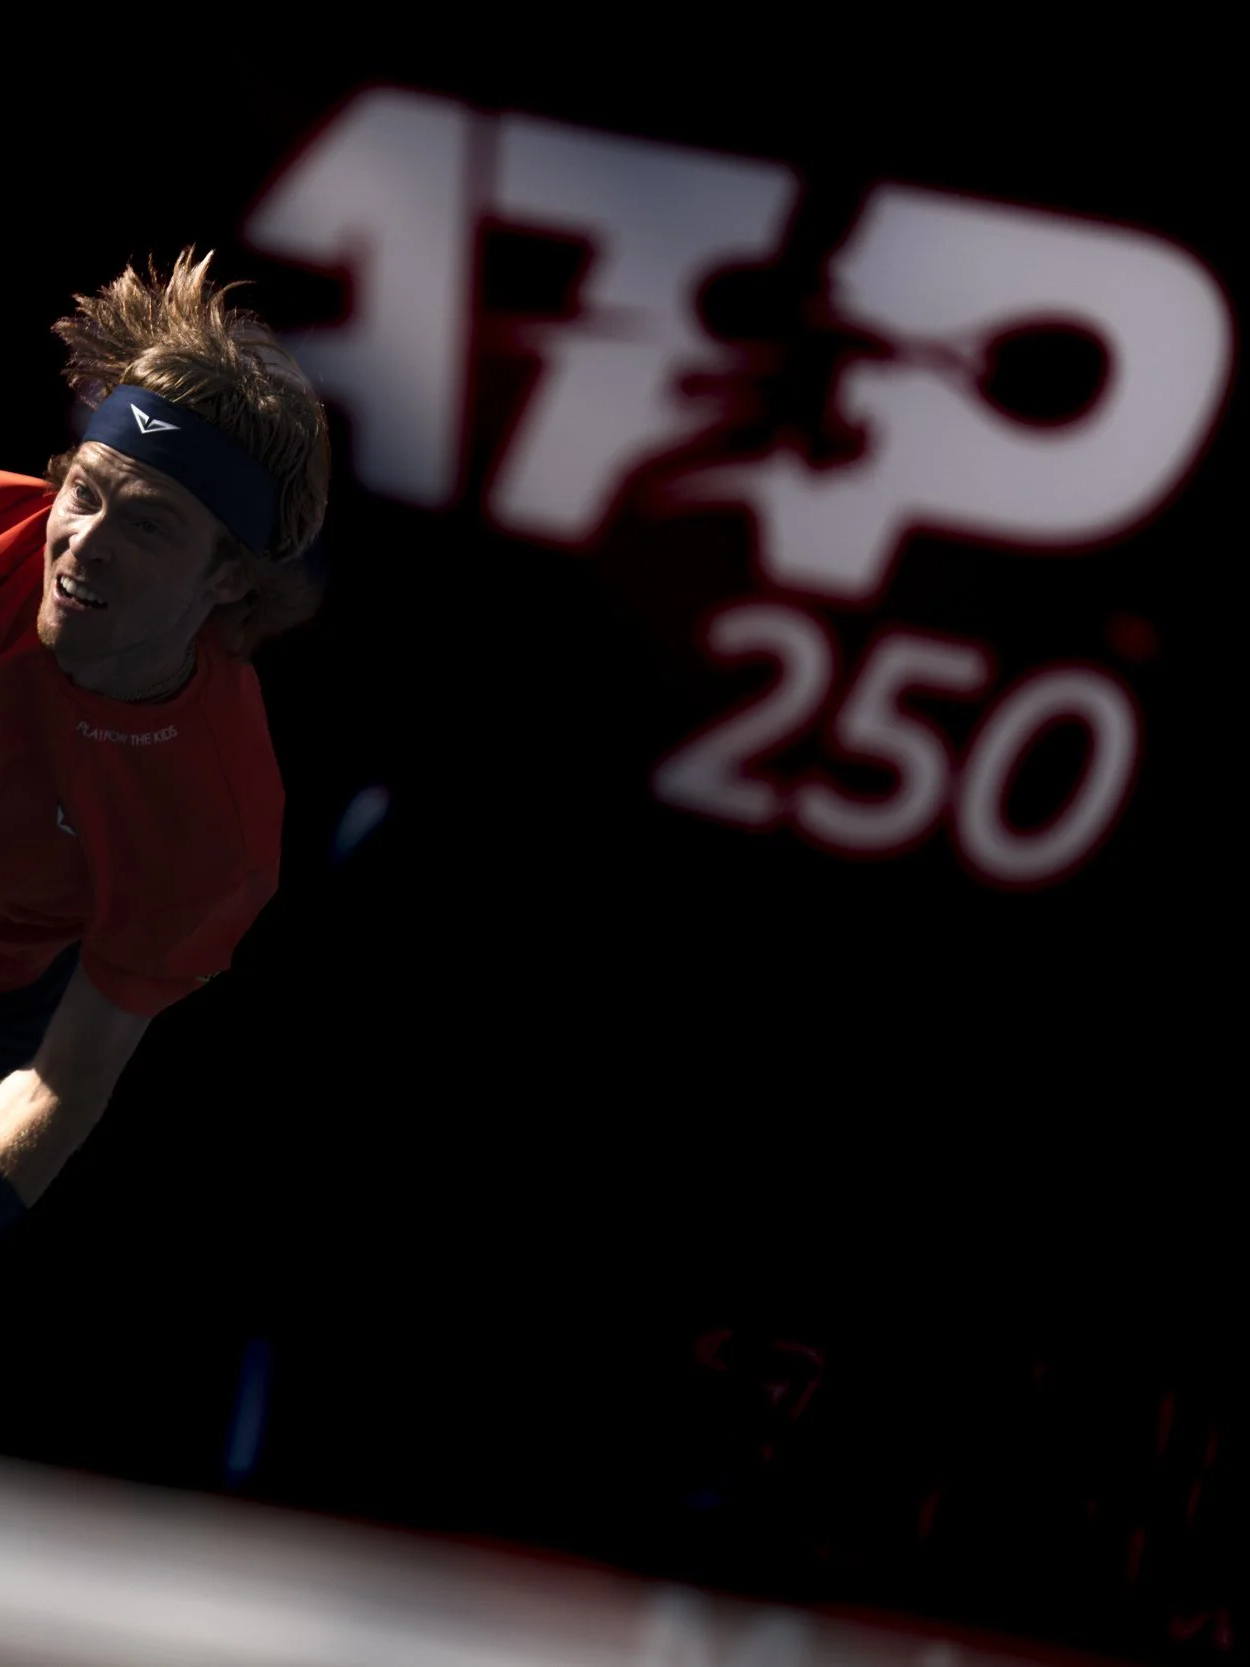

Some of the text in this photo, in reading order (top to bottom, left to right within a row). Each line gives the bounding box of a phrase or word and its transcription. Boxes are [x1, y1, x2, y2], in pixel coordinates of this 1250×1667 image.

[240, 90, 1234, 598] ATP
[130, 732, 152, 746] THE
[153, 724, 178, 744] KIDS
[655, 608, 1138, 880] 250
